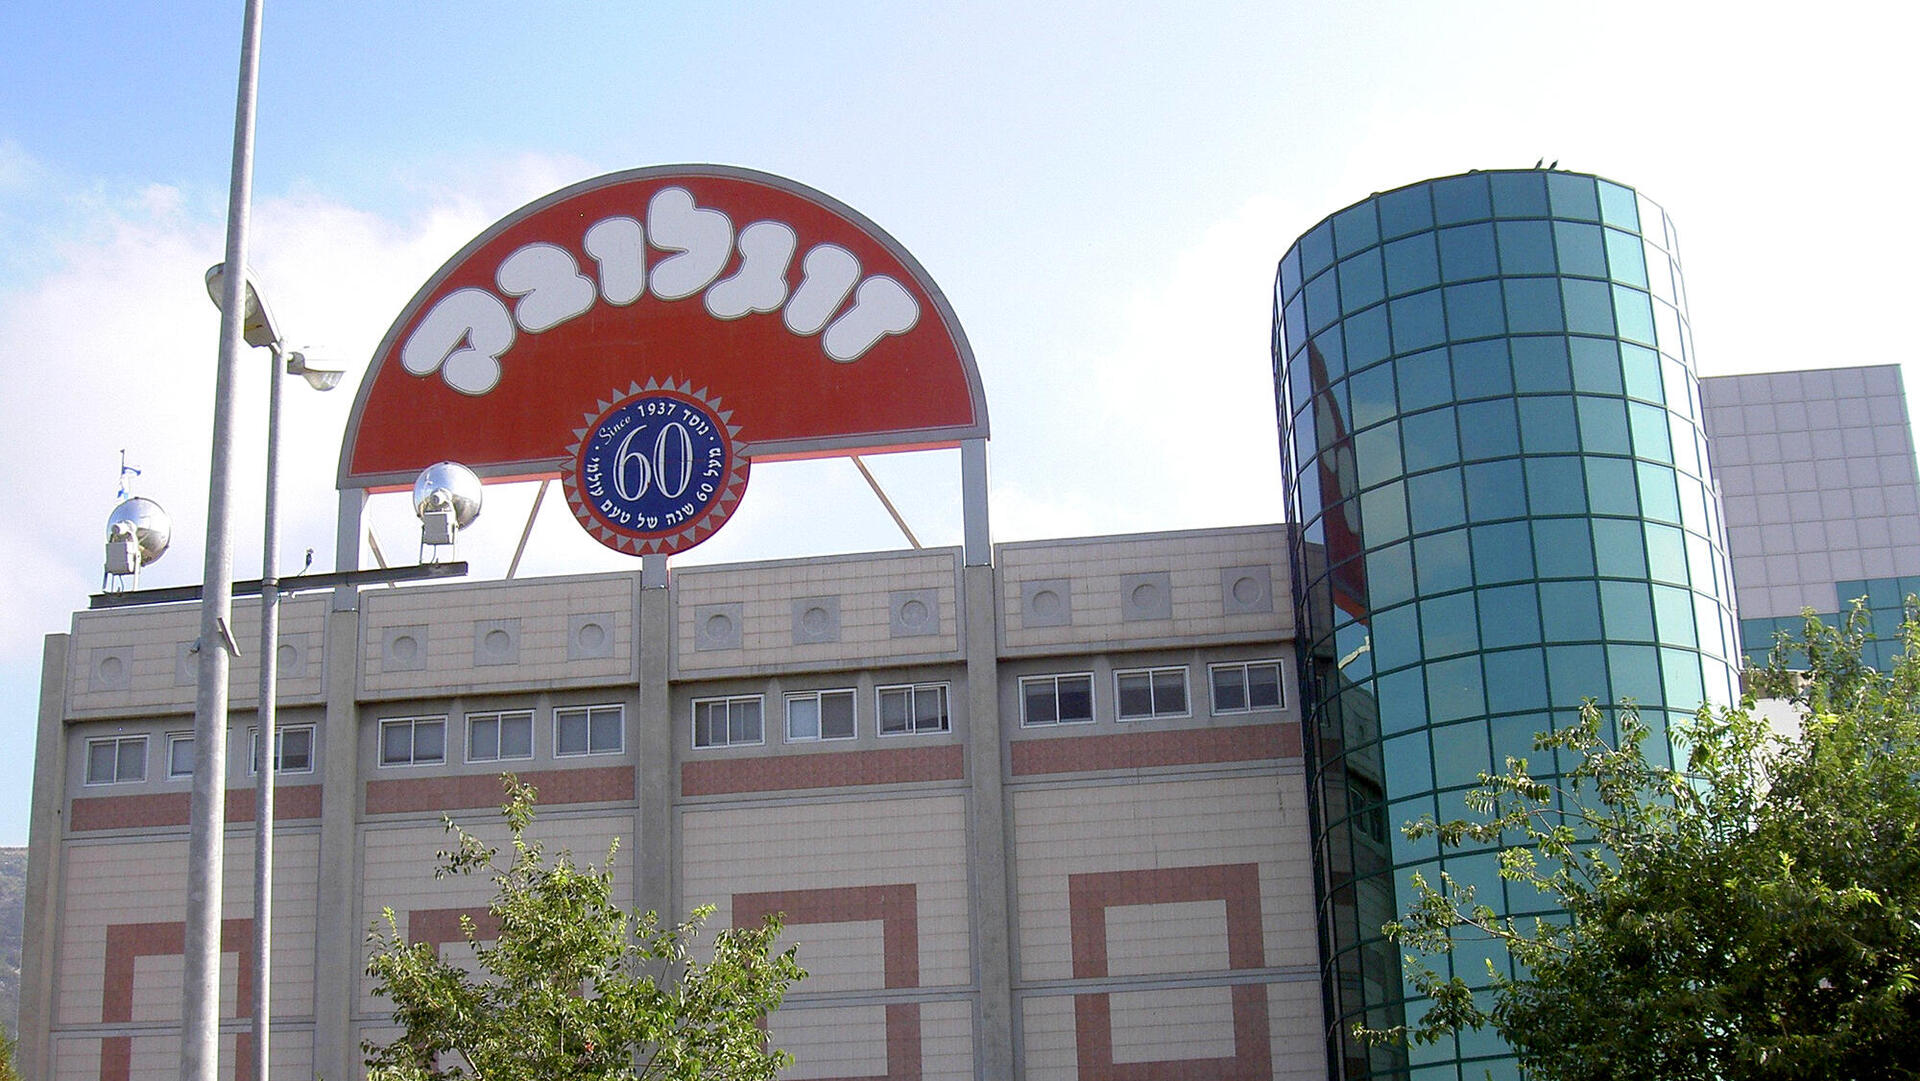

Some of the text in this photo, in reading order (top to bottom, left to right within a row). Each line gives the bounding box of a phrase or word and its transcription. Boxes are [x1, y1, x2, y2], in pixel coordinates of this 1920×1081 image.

[401, 186, 921, 395] זוגלובק
[599, 416, 631, 446] Since
[638, 403, 709, 436] נוסד 1937
[587, 447, 722, 529] מעל 60 שנה של טעם עולמי
[613, 422, 694, 501] 60
